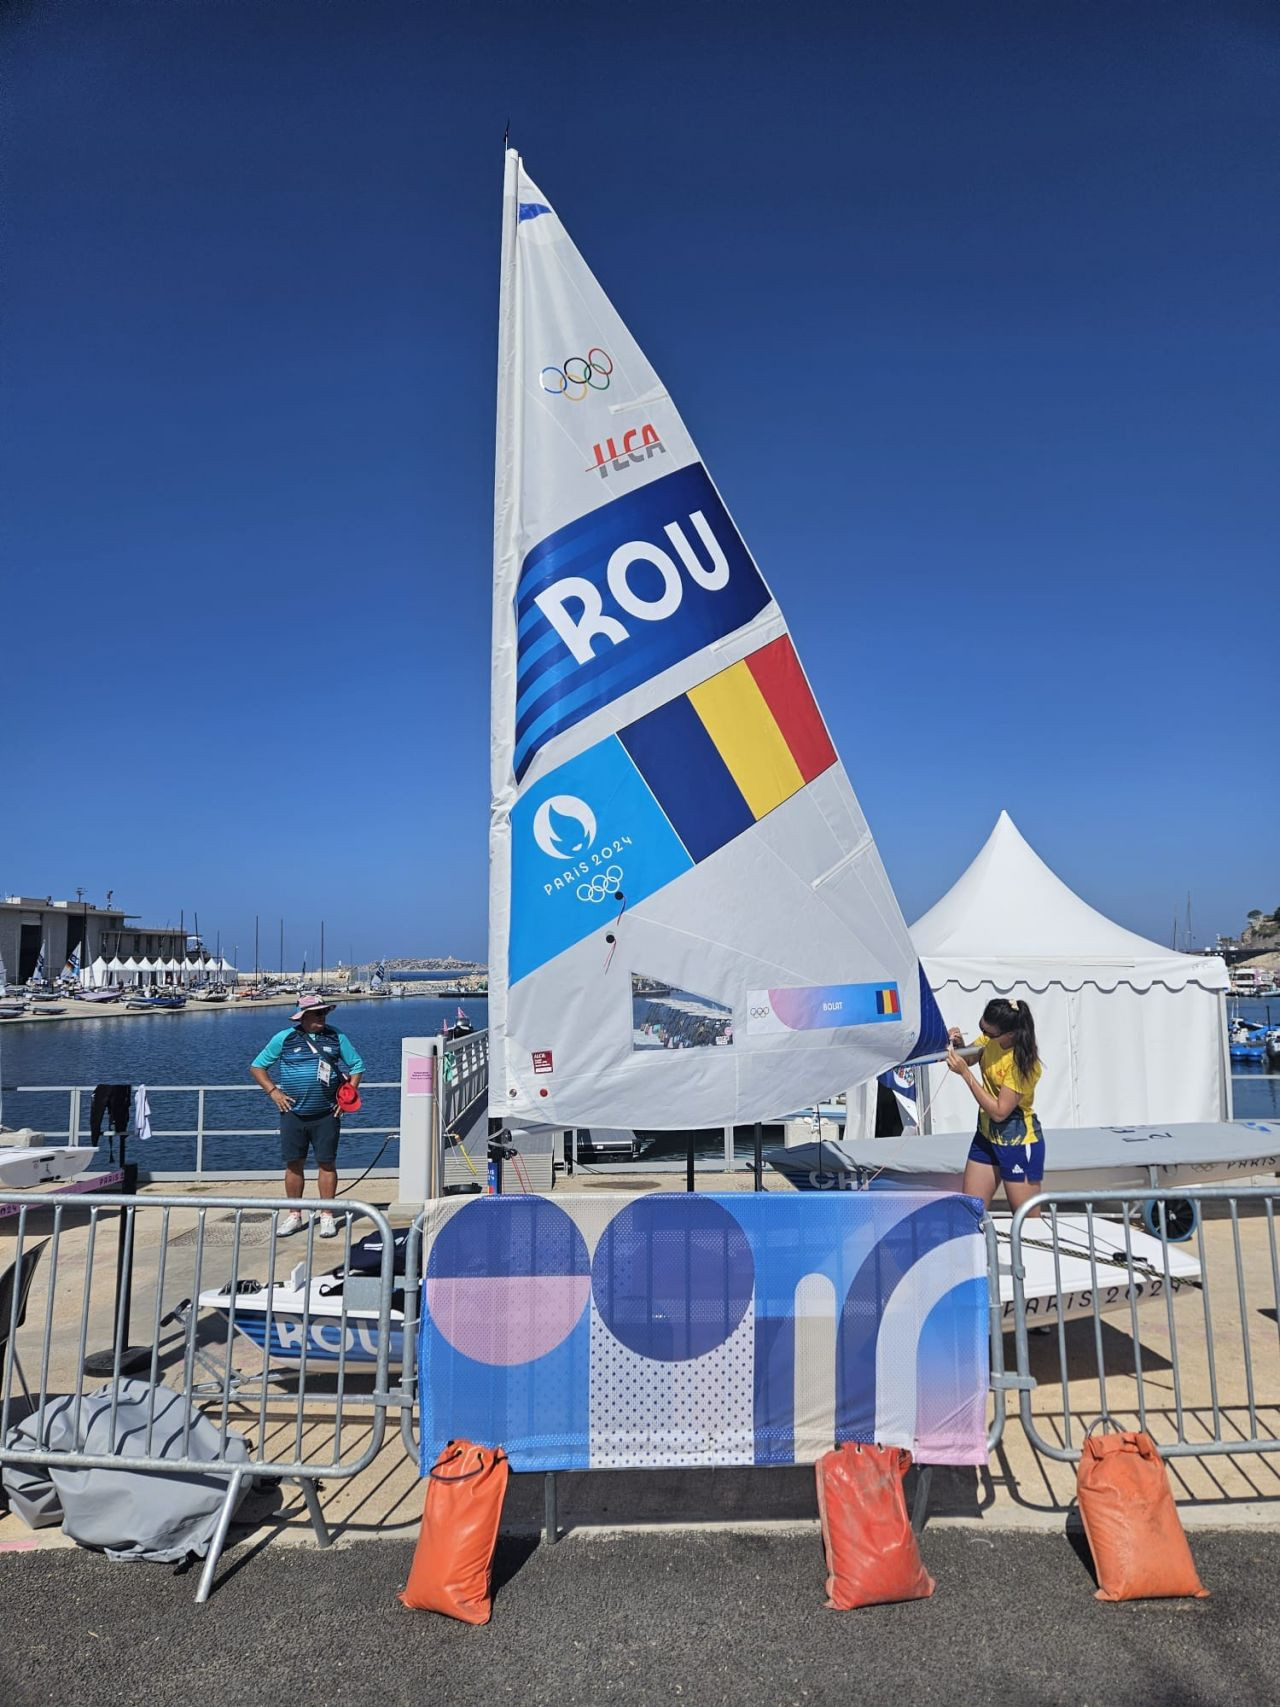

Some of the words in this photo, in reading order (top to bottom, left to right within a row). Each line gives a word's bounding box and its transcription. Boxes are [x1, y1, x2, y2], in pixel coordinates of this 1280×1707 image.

[591, 423, 667, 480] ILCA
[534, 510, 730, 665] ROU
[543, 862, 589, 896] PARIS
[591, 836, 633, 866] 2024
[822, 1001, 843, 1011] BOLAT
[809, 1170, 870, 1190] CHI
[273, 1312, 392, 1356] ROU
